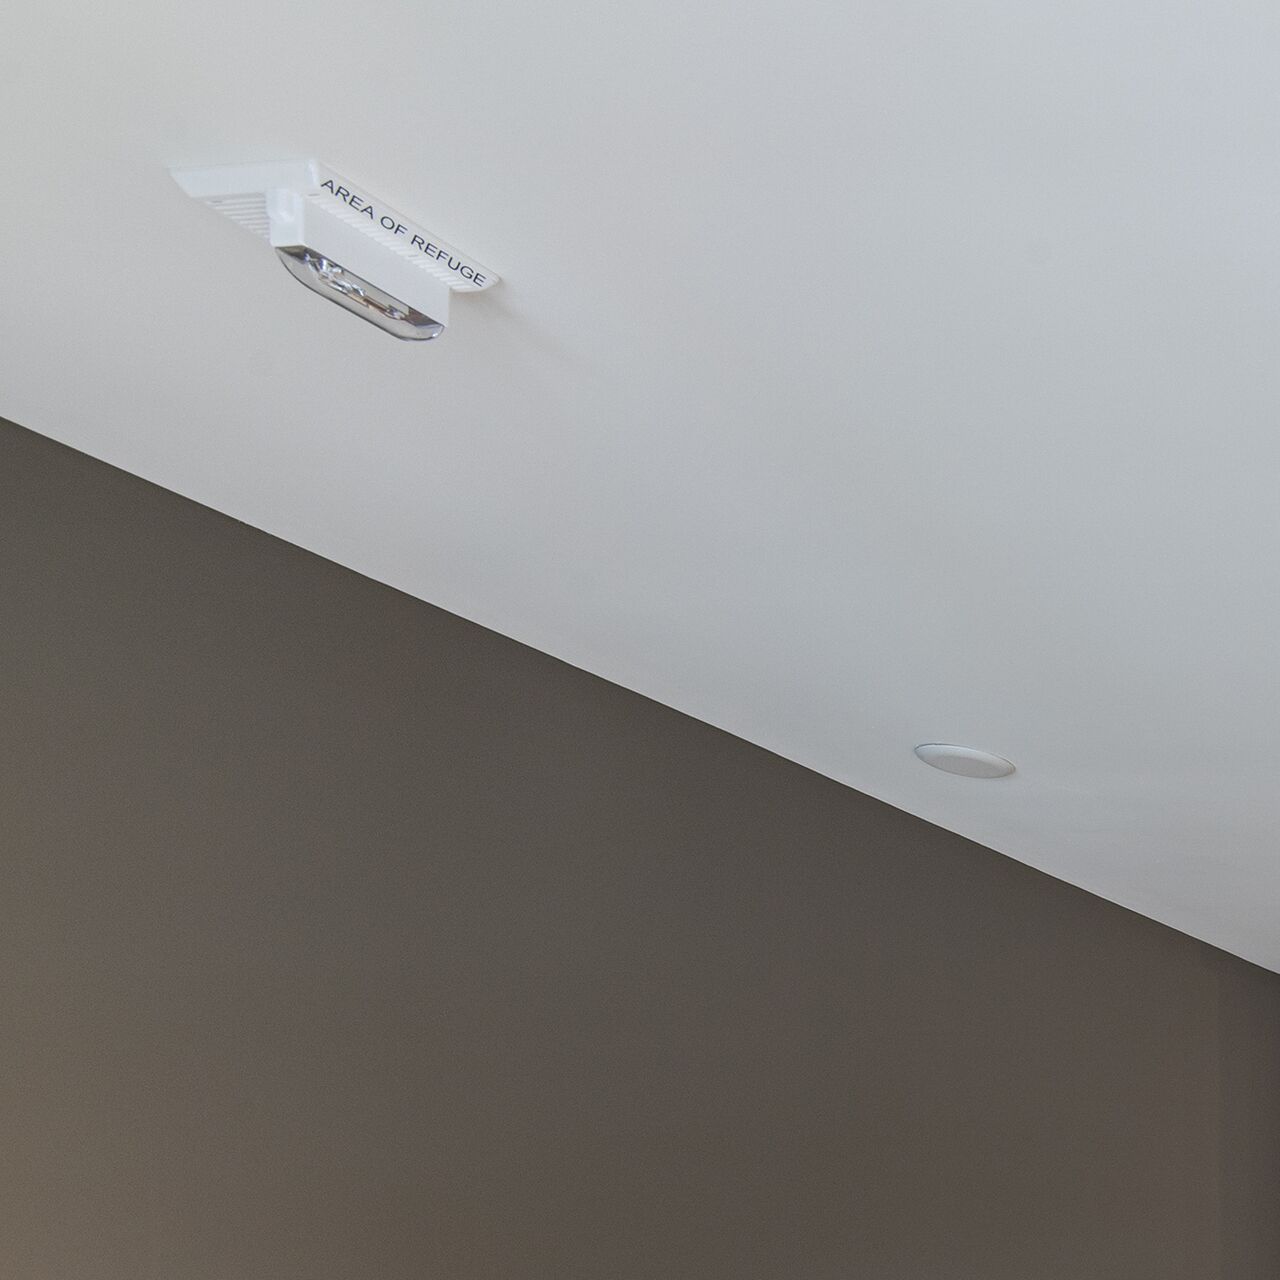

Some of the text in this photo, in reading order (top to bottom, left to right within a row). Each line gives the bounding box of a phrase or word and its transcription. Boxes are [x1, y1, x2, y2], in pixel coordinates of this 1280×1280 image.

[321, 179, 487, 287] AREA OF REFUGE
